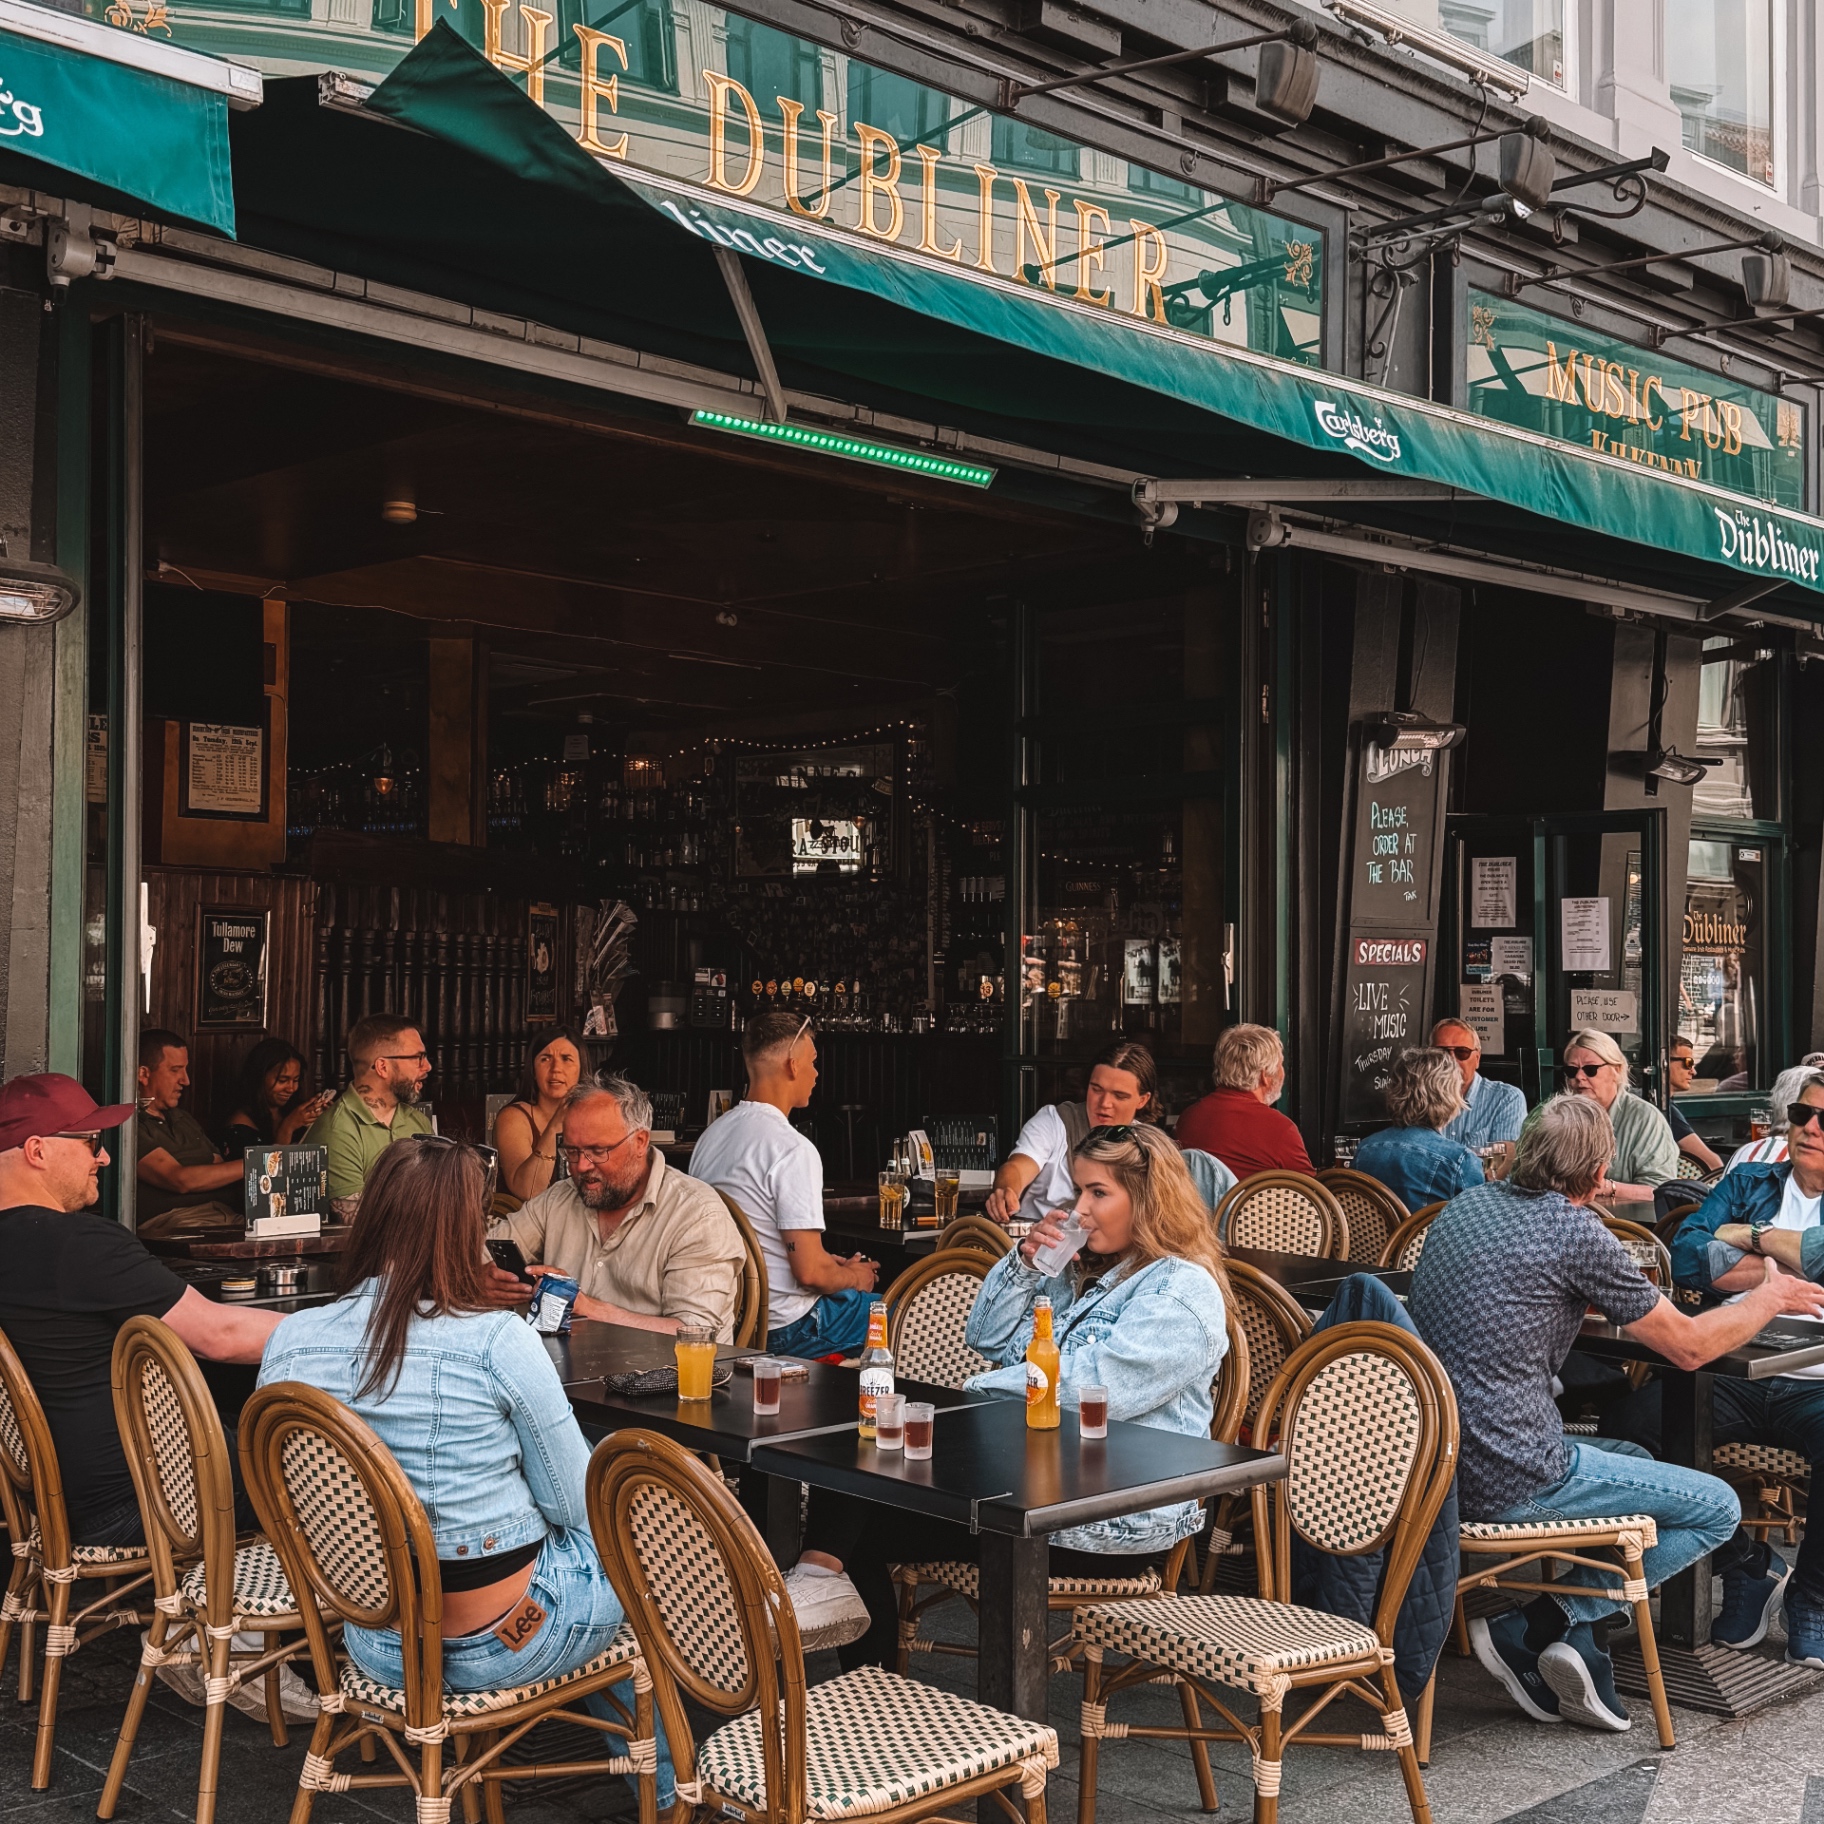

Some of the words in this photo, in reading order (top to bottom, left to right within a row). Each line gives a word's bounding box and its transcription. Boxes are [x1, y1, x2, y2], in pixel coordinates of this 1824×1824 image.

[414, 0, 629, 160] HE
[702, 69, 1171, 325] DUBLINER
[661, 200, 826, 274] liner
[1546, 340, 1664, 431] MUSIC
[1680, 386, 1743, 456] PUB
[1314, 400, 1401, 462] Carlsberg
[1735, 509, 1750, 528] The
[1714, 506, 1820, 582] Dubliner
[1373, 832, 1399, 857] ORDER
[1404, 832, 1418, 854] AT
[1366, 861, 1383, 885] THE
[1388, 858, 1414, 884] BAR
[1065, 880, 1101, 892] GUINNESS
[212, 921, 256, 938] Tullamore
[1682, 913, 1747, 945] Dubliner
[1693, 911, 1703, 921] The
[223, 937, 244, 953] Dew
[1358, 942, 1422, 964] SPECIALS
[1358, 983, 1389, 1010] LIVE
[1604, 997, 1618, 1006] USE
[1373, 1013, 1407, 1040] MUSIC
[1577, 1012, 1597, 1021] OTHER
[1602, 1013, 1620, 1022] DOOR
[501, 1605, 542, 1645] Lee
